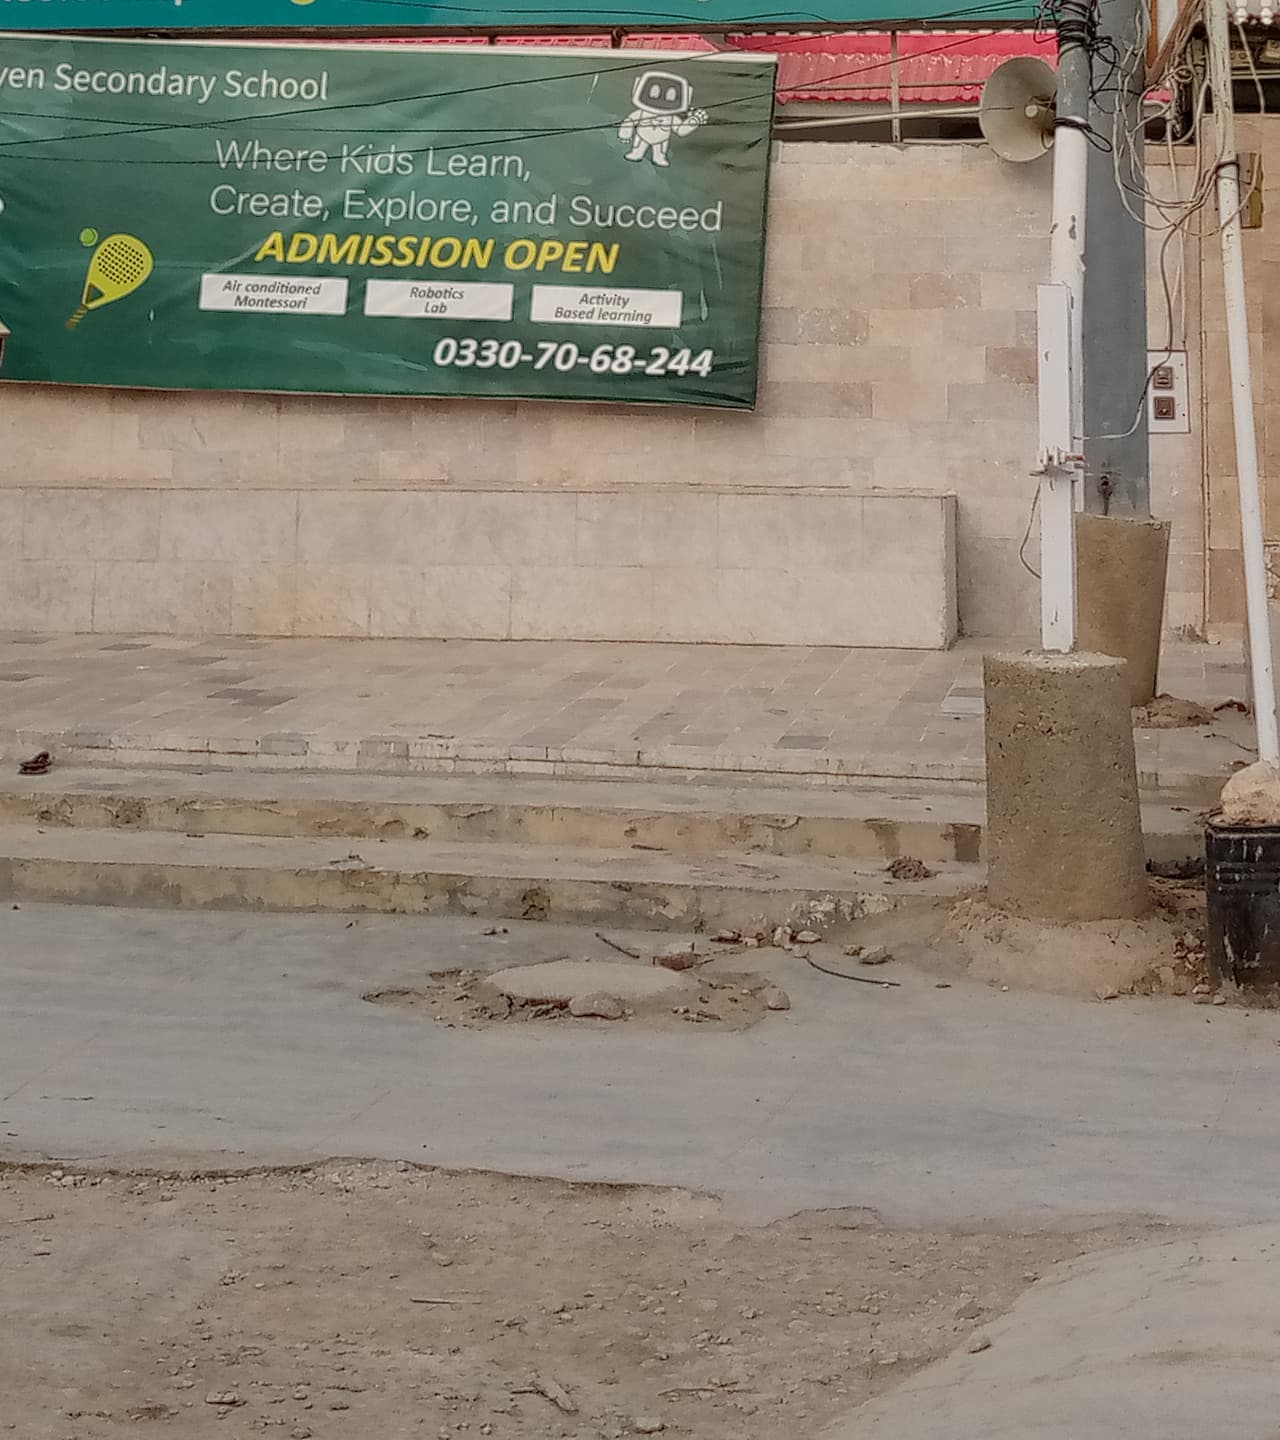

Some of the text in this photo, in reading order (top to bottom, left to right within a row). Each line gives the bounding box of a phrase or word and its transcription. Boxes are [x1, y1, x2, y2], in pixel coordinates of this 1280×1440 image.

[53, 63, 216, 105] Secondary
[223, 70, 329, 102] School
[214, 138, 532, 181] Where Kids Learn,
[209, 183, 724, 233] Create, Explore, and Succeed
[254, 231, 622, 275] ADMISSION OPEN
[222, 280, 322, 296] Air conditioned
[409, 285, 465, 301] Robotics
[233, 294, 308, 310] Montessori
[424, 300, 448, 315] Lab
[578, 290, 631, 309] Activity
[554, 306, 653, 326] Based learning
[432, 336, 716, 379] 0330-70-68-244
